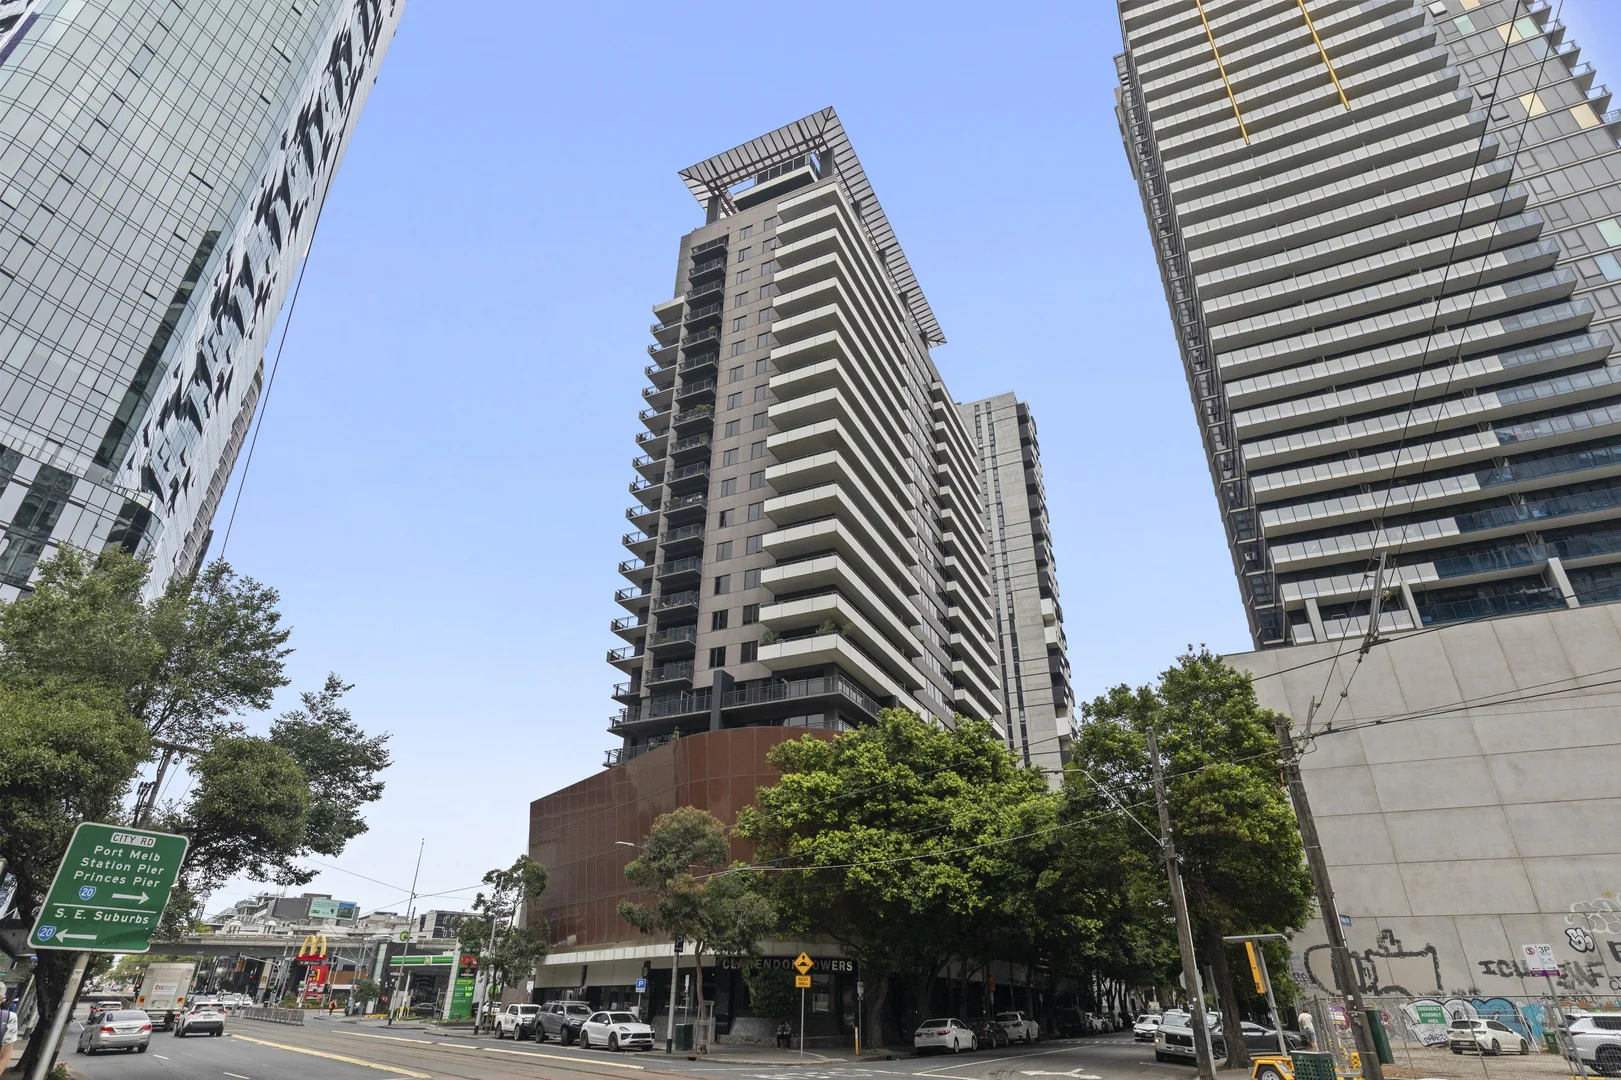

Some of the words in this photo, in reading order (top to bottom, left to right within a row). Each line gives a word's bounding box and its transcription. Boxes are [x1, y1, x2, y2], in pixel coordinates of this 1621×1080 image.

[113, 834, 137, 844] CITY
[140, 838, 154, 846] RD
[94, 846, 123, 857] Port
[129, 850, 161, 862] Melb
[80, 857, 131, 871] Station
[137, 864, 165, 875] Pier
[73, 871, 126, 884] Princes
[133, 876, 160, 888] Pier
[81, 888, 94, 897] 20
[54, 908, 67, 918] S.
[74, 910, 86, 920] E.
[93, 911, 149, 924] Suburbs
[40, 928, 52, 937] 20
[1538, 946, 1550, 954] 3P
